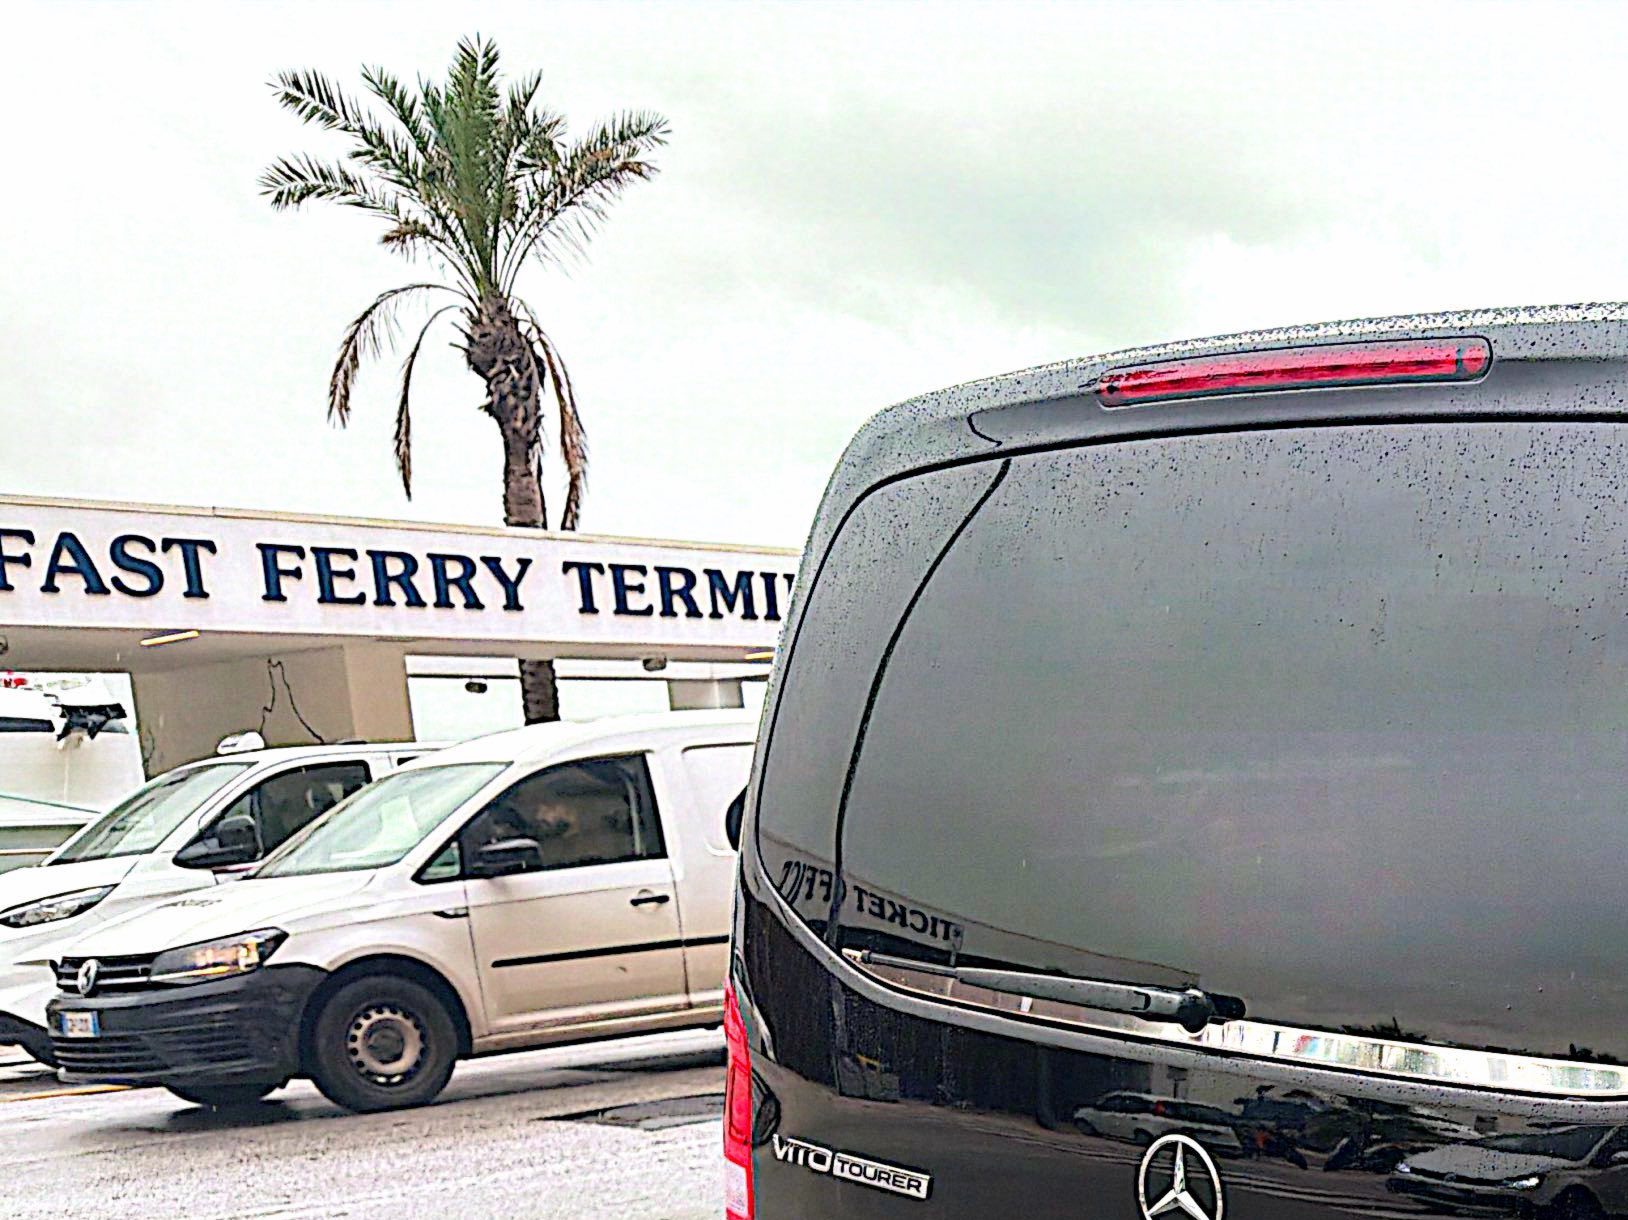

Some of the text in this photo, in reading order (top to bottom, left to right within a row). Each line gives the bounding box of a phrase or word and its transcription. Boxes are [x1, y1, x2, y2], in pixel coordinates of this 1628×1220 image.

[0, 528, 218, 598] FAST
[256, 543, 533, 611] FERRY
[772, 1133, 923, 1193] VITO TOURER
